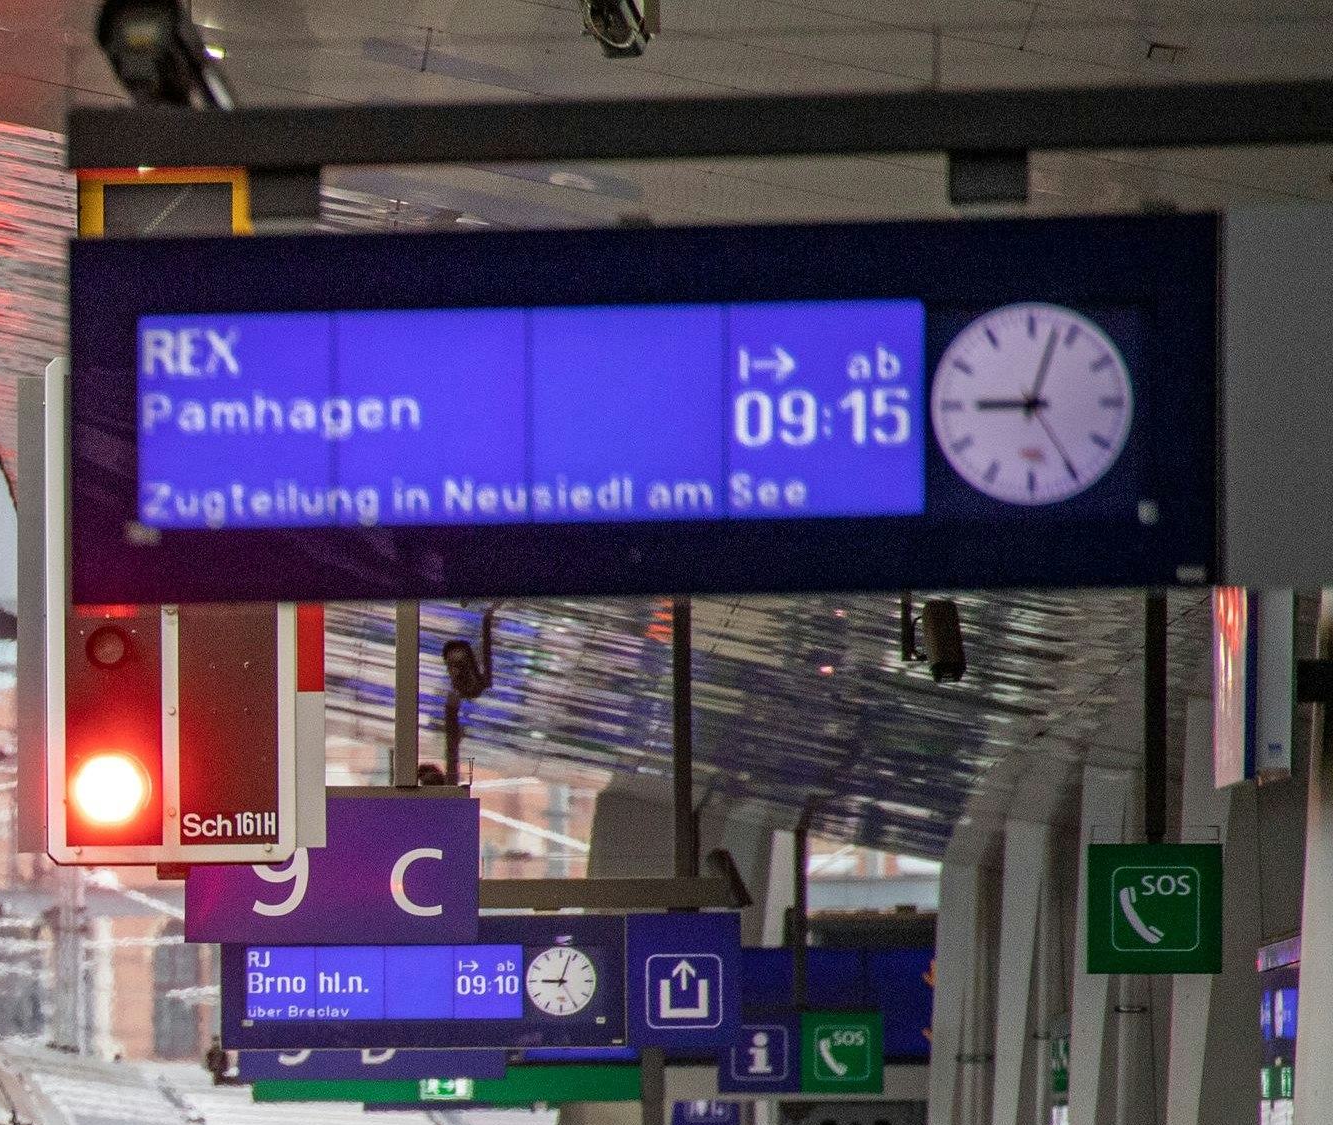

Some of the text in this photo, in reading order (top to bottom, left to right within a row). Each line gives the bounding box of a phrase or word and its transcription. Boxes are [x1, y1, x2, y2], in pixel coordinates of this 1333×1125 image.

[141, 328, 240, 378] REX
[847, 345, 902, 381] ab
[141, 393, 421, 441] Pamhagen
[734, 389, 911, 446] 09:15
[143, 473, 808, 528] Zugteilung in Neusiedl am See
[390, 848, 443, 917] C
[1141, 874, 1191, 896] SOS
[247, 951, 271, 968] RJ
[496, 960, 516, 972] ab
[247, 971, 370, 994] Brno hl.n.
[457, 975, 519, 995] 09:10
[247, 1006, 282, 1018] über
[833, 1030, 865, 1047] SOS
